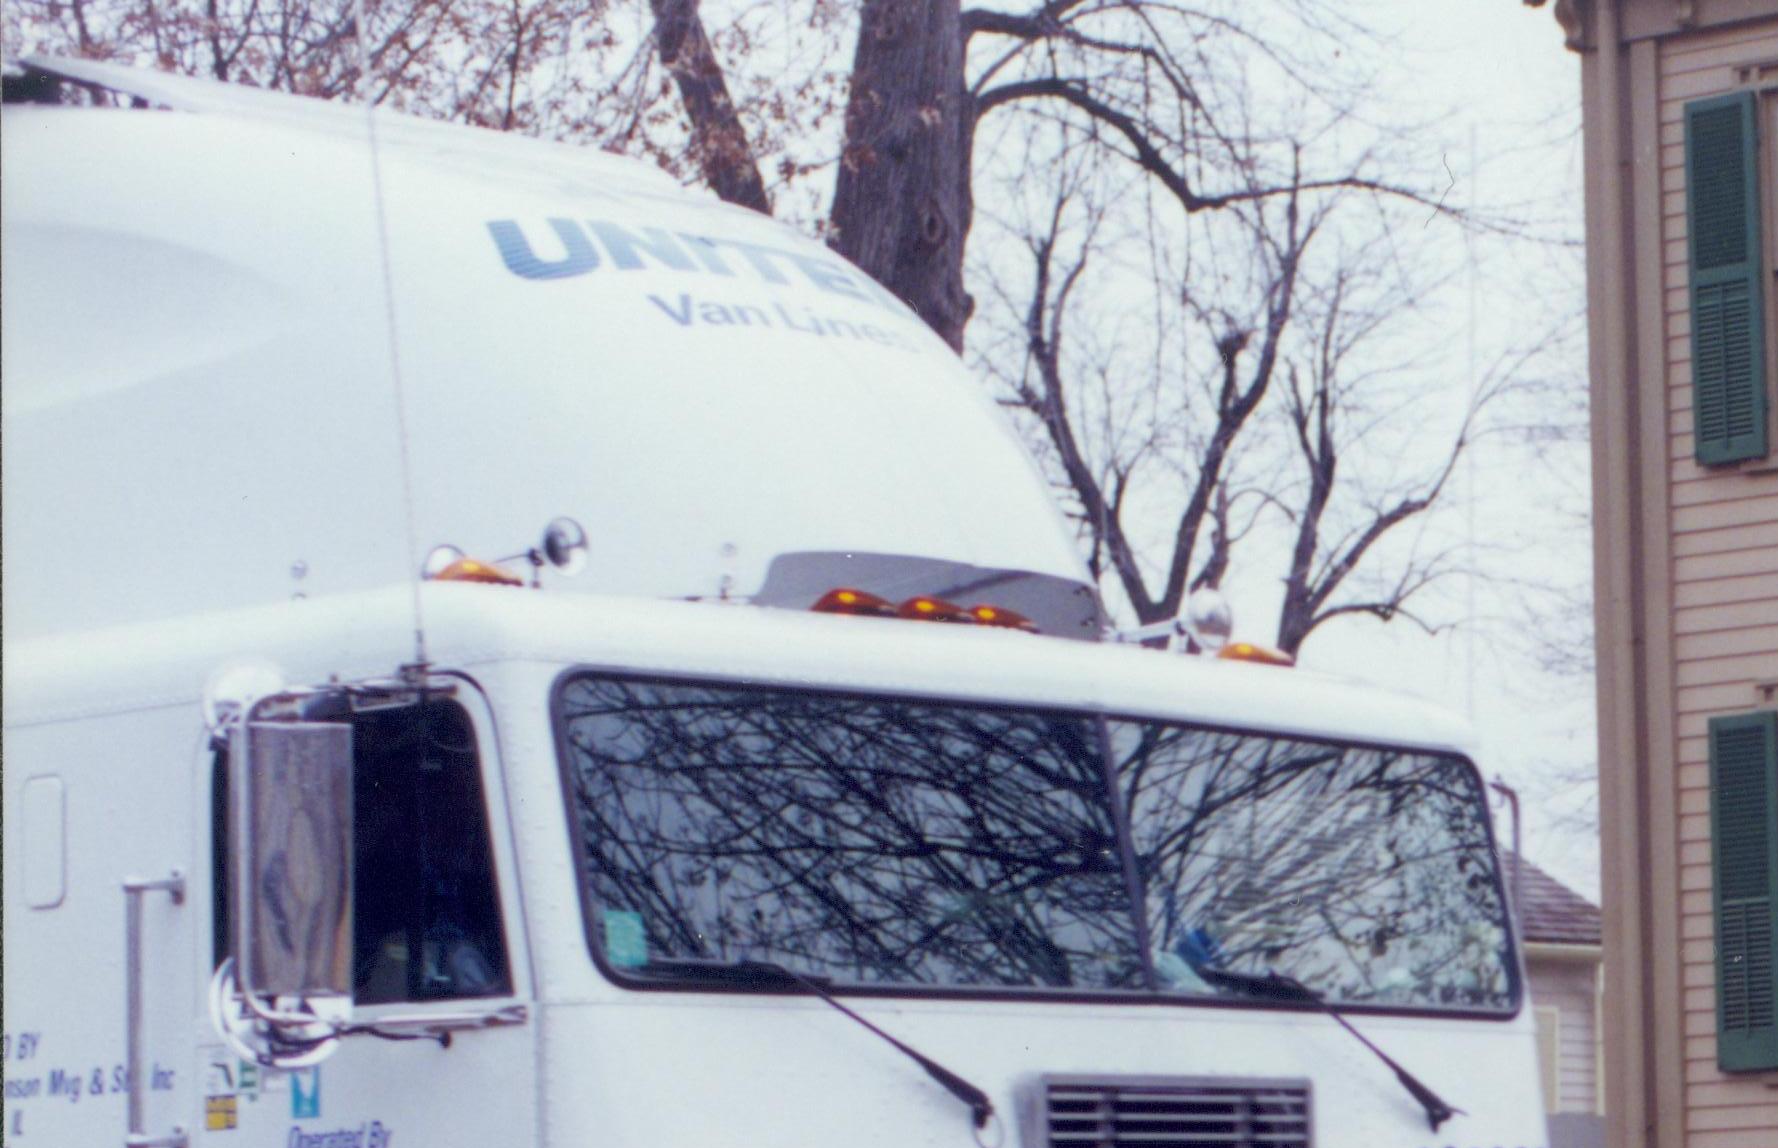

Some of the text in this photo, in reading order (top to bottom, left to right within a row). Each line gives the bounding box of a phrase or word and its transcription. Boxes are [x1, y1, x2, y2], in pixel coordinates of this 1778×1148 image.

[646, 293, 773, 329] Van
[49, 1068, 82, 1103] Mvg
[89, 1067, 104, 1095] &
